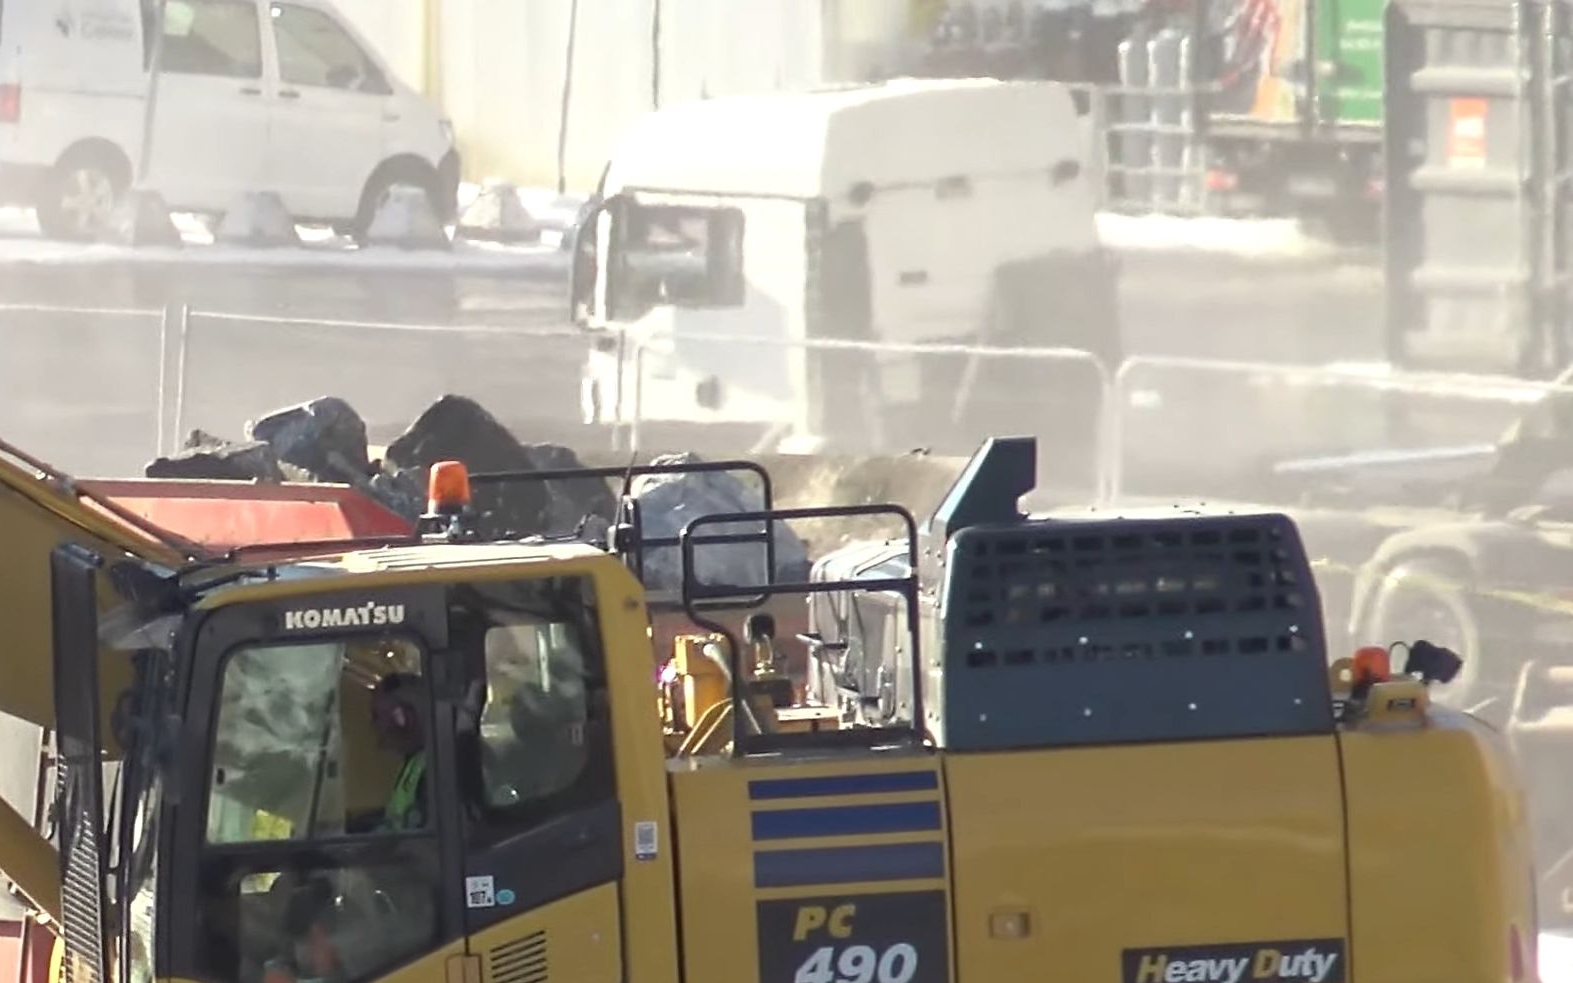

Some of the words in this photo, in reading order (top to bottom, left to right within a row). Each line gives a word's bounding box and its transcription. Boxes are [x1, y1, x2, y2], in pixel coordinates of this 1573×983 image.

[285, 601, 405, 629] KOMATSU
[793, 903, 856, 941] PC
[1253, 948, 1337, 983] Duty
